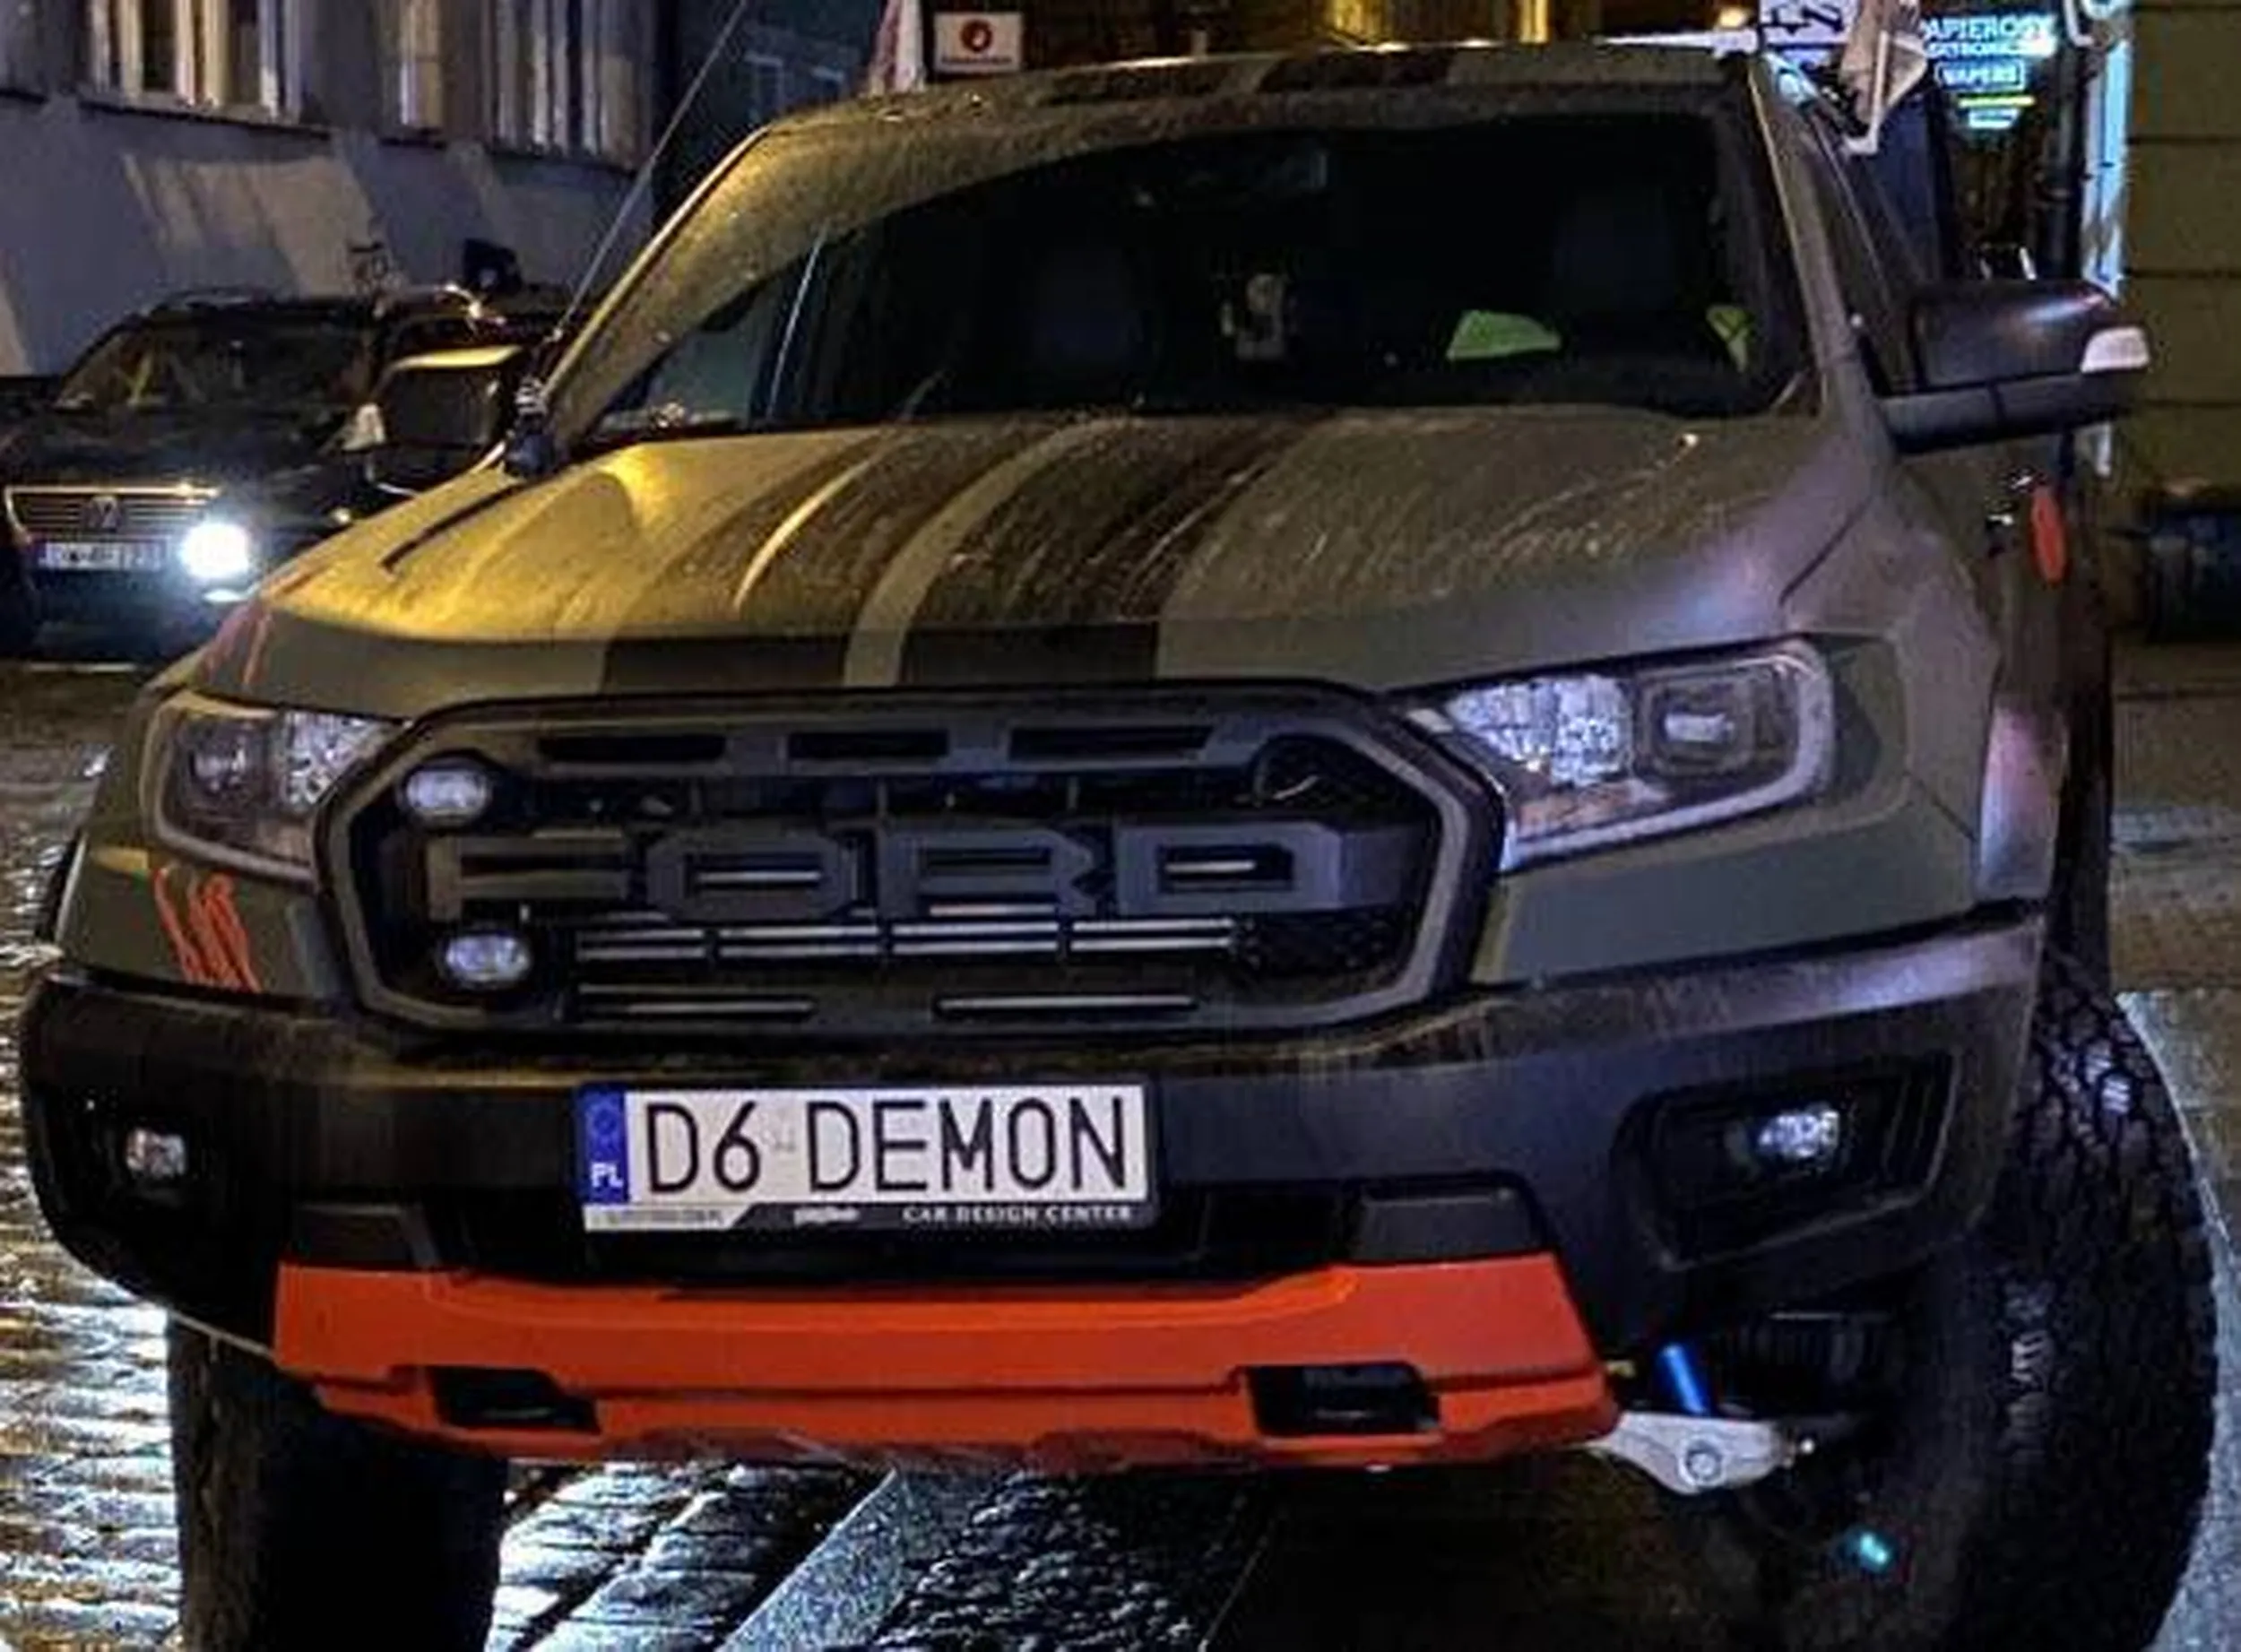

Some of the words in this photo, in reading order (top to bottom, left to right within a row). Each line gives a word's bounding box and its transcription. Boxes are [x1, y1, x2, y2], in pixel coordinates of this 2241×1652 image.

[425, 821, 1342, 921] FORD
[645, 1101, 762, 1193] D6
[806, 1096, 1127, 1190] DEMON
[591, 1163, 623, 1188] PL
[902, 1206, 947, 1223] CAR
[956, 1206, 1037, 1224] DESIGN
[1045, 1206, 1131, 1224] CENTER
